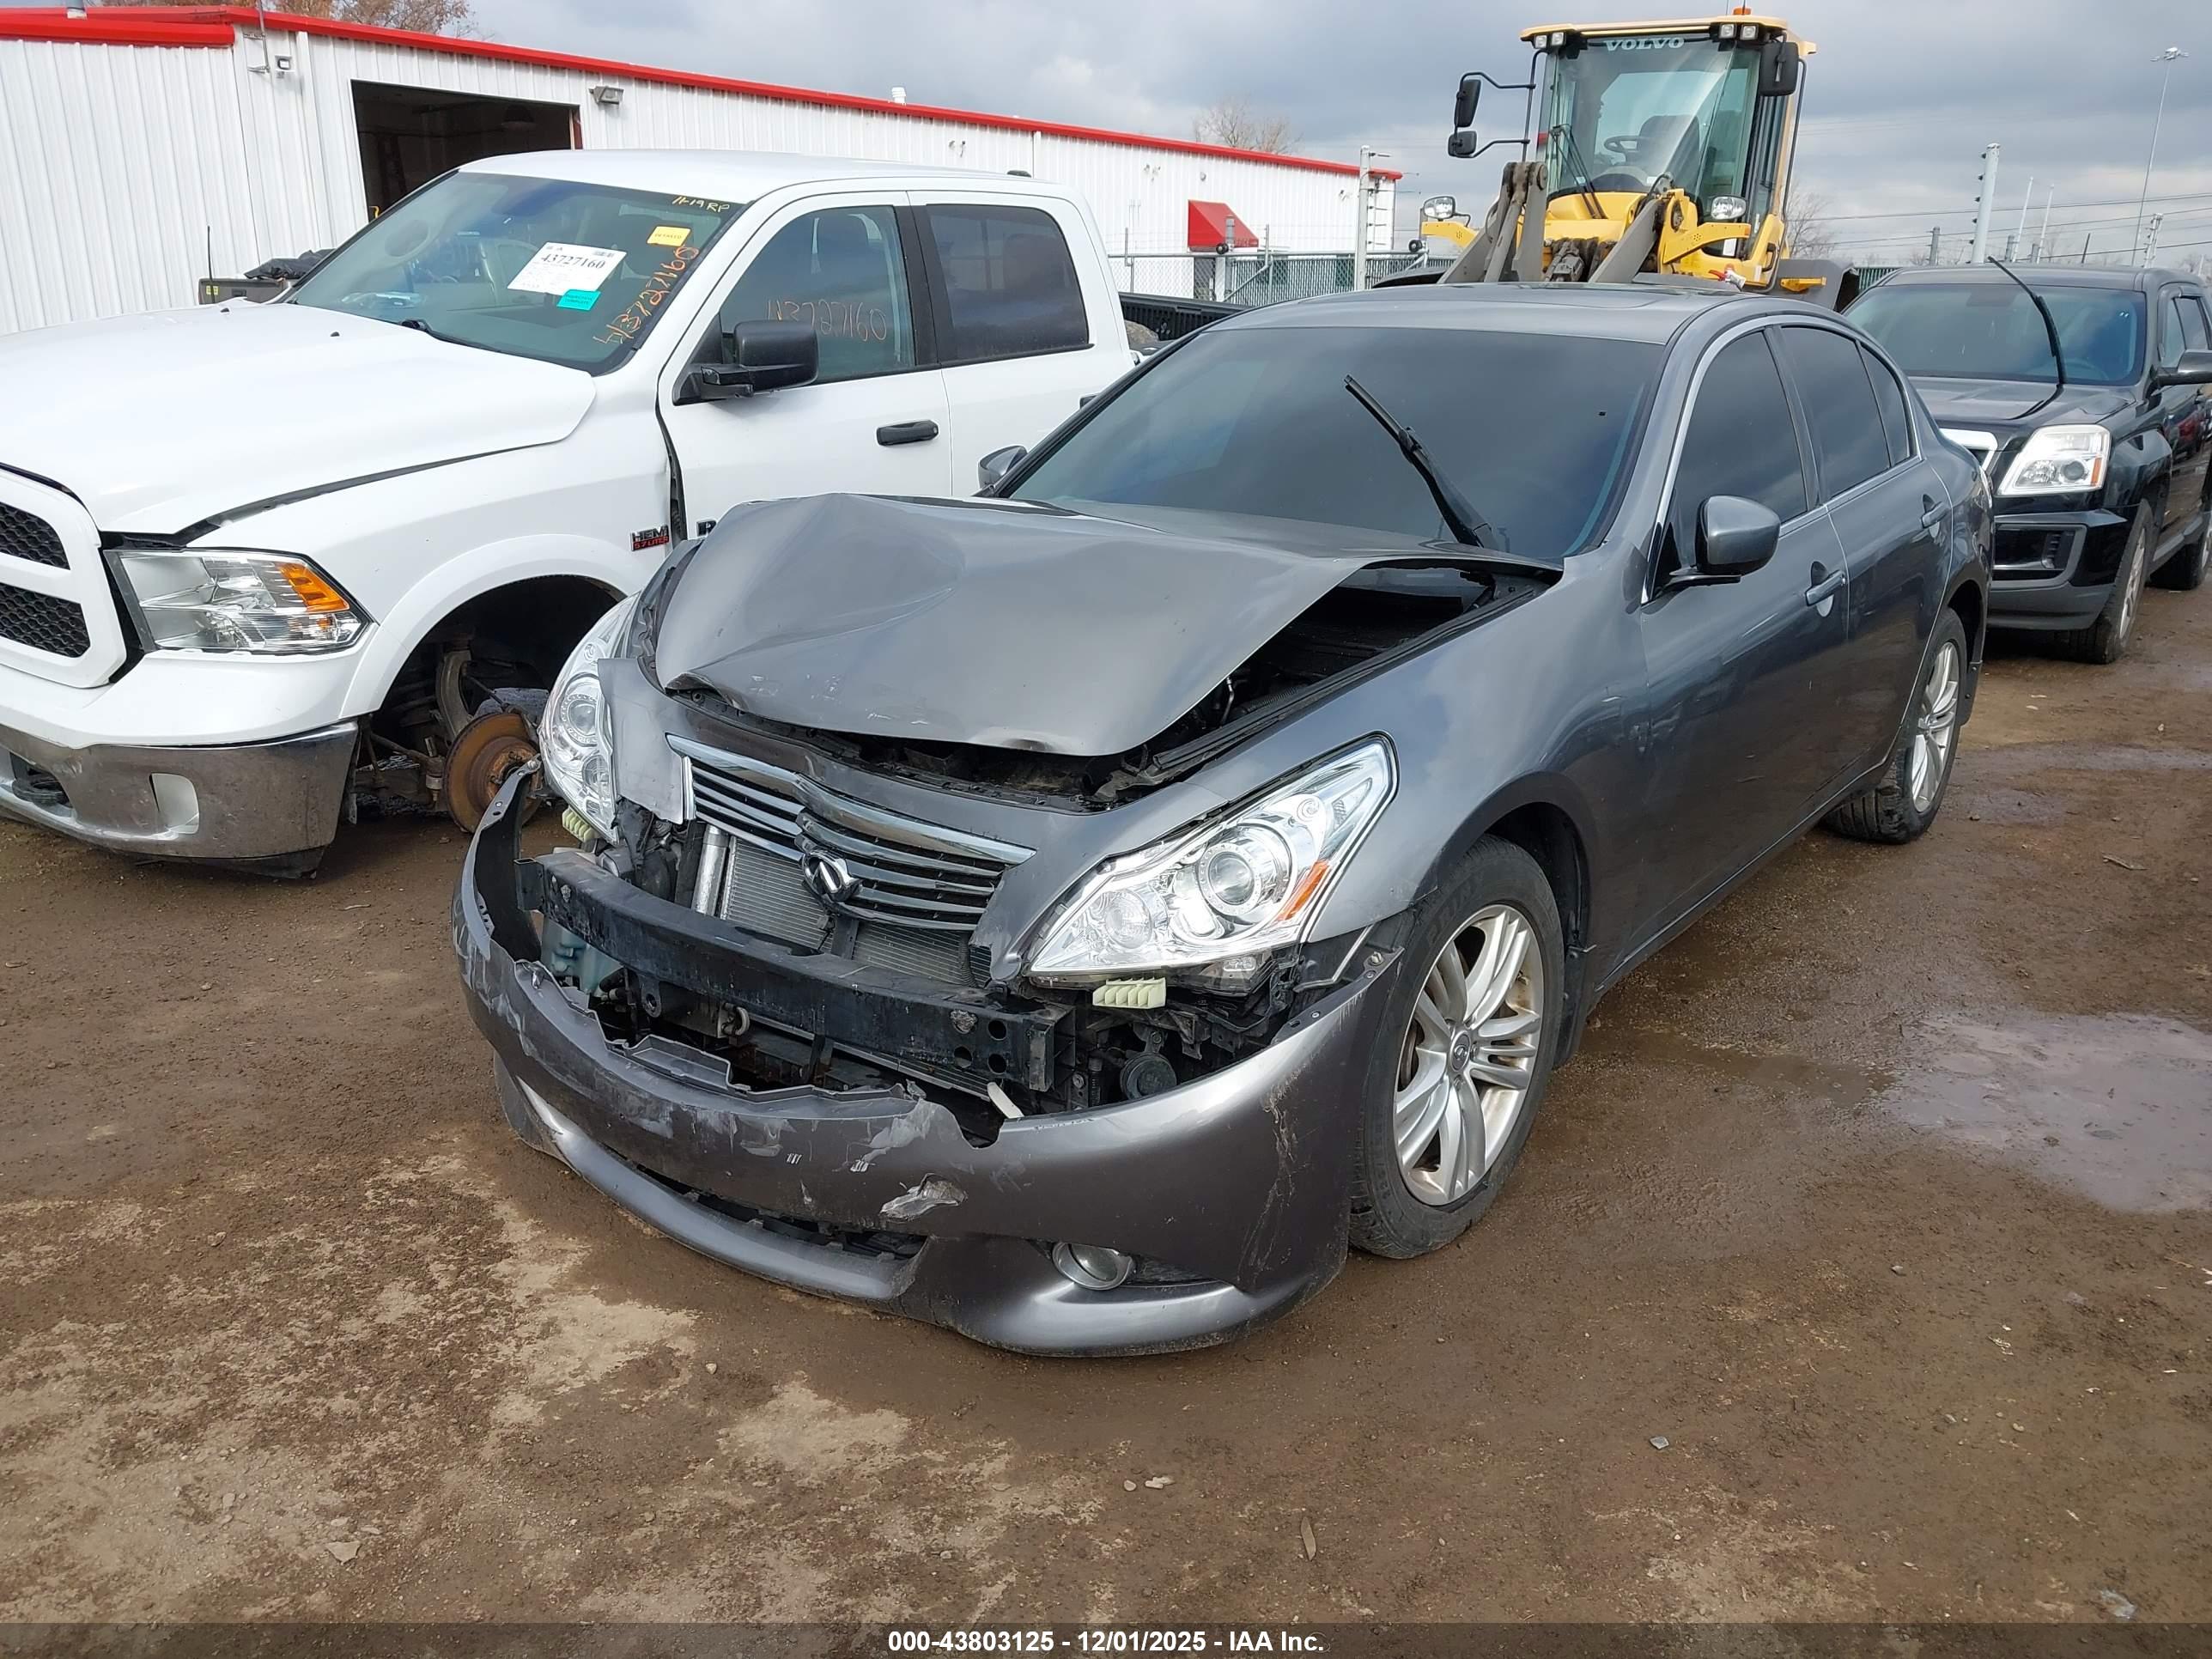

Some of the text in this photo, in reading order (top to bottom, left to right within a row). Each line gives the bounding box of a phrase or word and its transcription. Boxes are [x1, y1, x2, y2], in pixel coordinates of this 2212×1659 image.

[1602, 37, 1685, 52] VOLVO
[706, 202, 730, 213] RP
[540, 252, 606, 270] 43727160
[631, 525, 669, 542] HEMI
[647, 536, 669, 547] LITER
